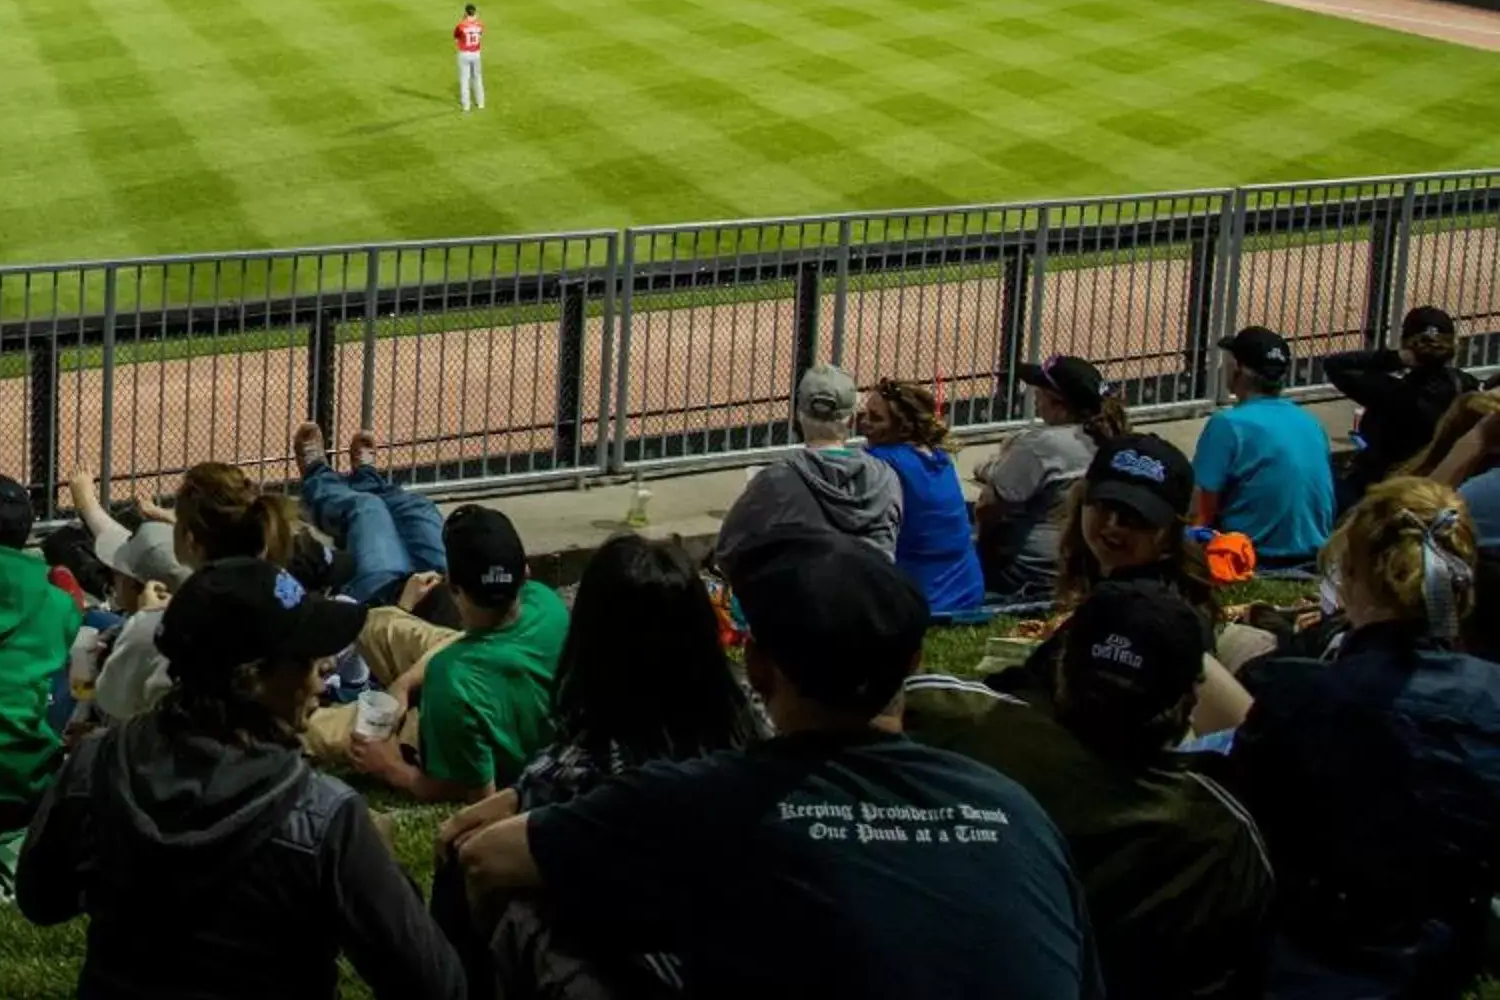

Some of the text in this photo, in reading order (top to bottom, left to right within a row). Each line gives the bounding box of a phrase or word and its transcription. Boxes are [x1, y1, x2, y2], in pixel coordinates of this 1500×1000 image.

[777, 801, 854, 821] Keeping
[860, 801, 955, 822] Providence
[808, 822, 998, 843] One Punk at a Time
